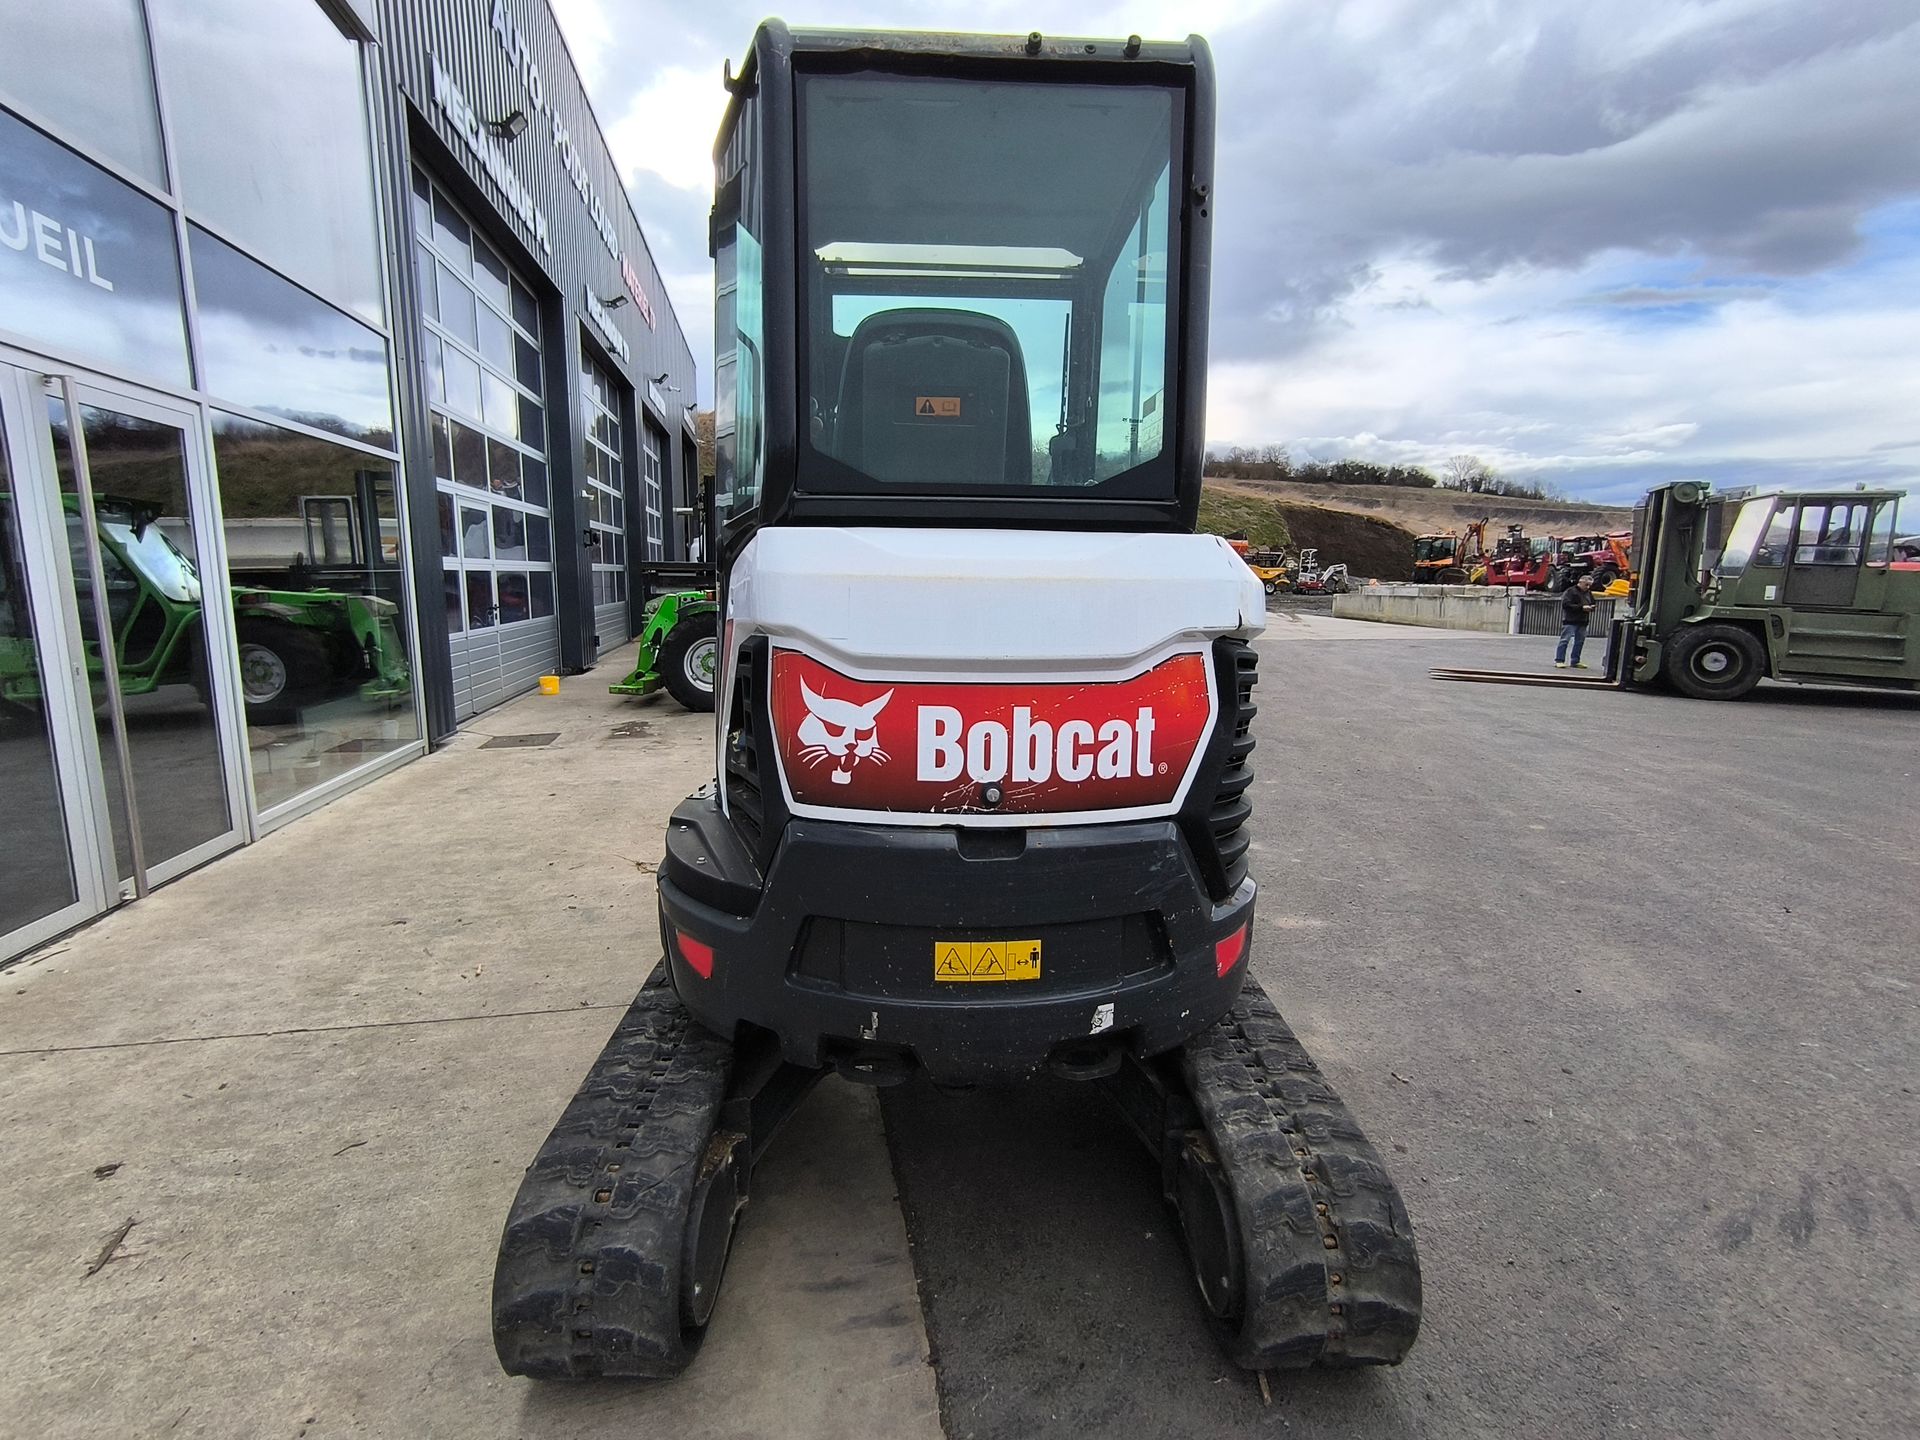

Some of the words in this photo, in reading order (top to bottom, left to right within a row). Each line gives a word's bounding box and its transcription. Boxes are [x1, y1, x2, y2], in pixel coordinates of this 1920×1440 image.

[491, 0, 544, 112] AUTO
[552, 107, 589, 206] POIDS
[589, 182, 620, 261] LOURD
